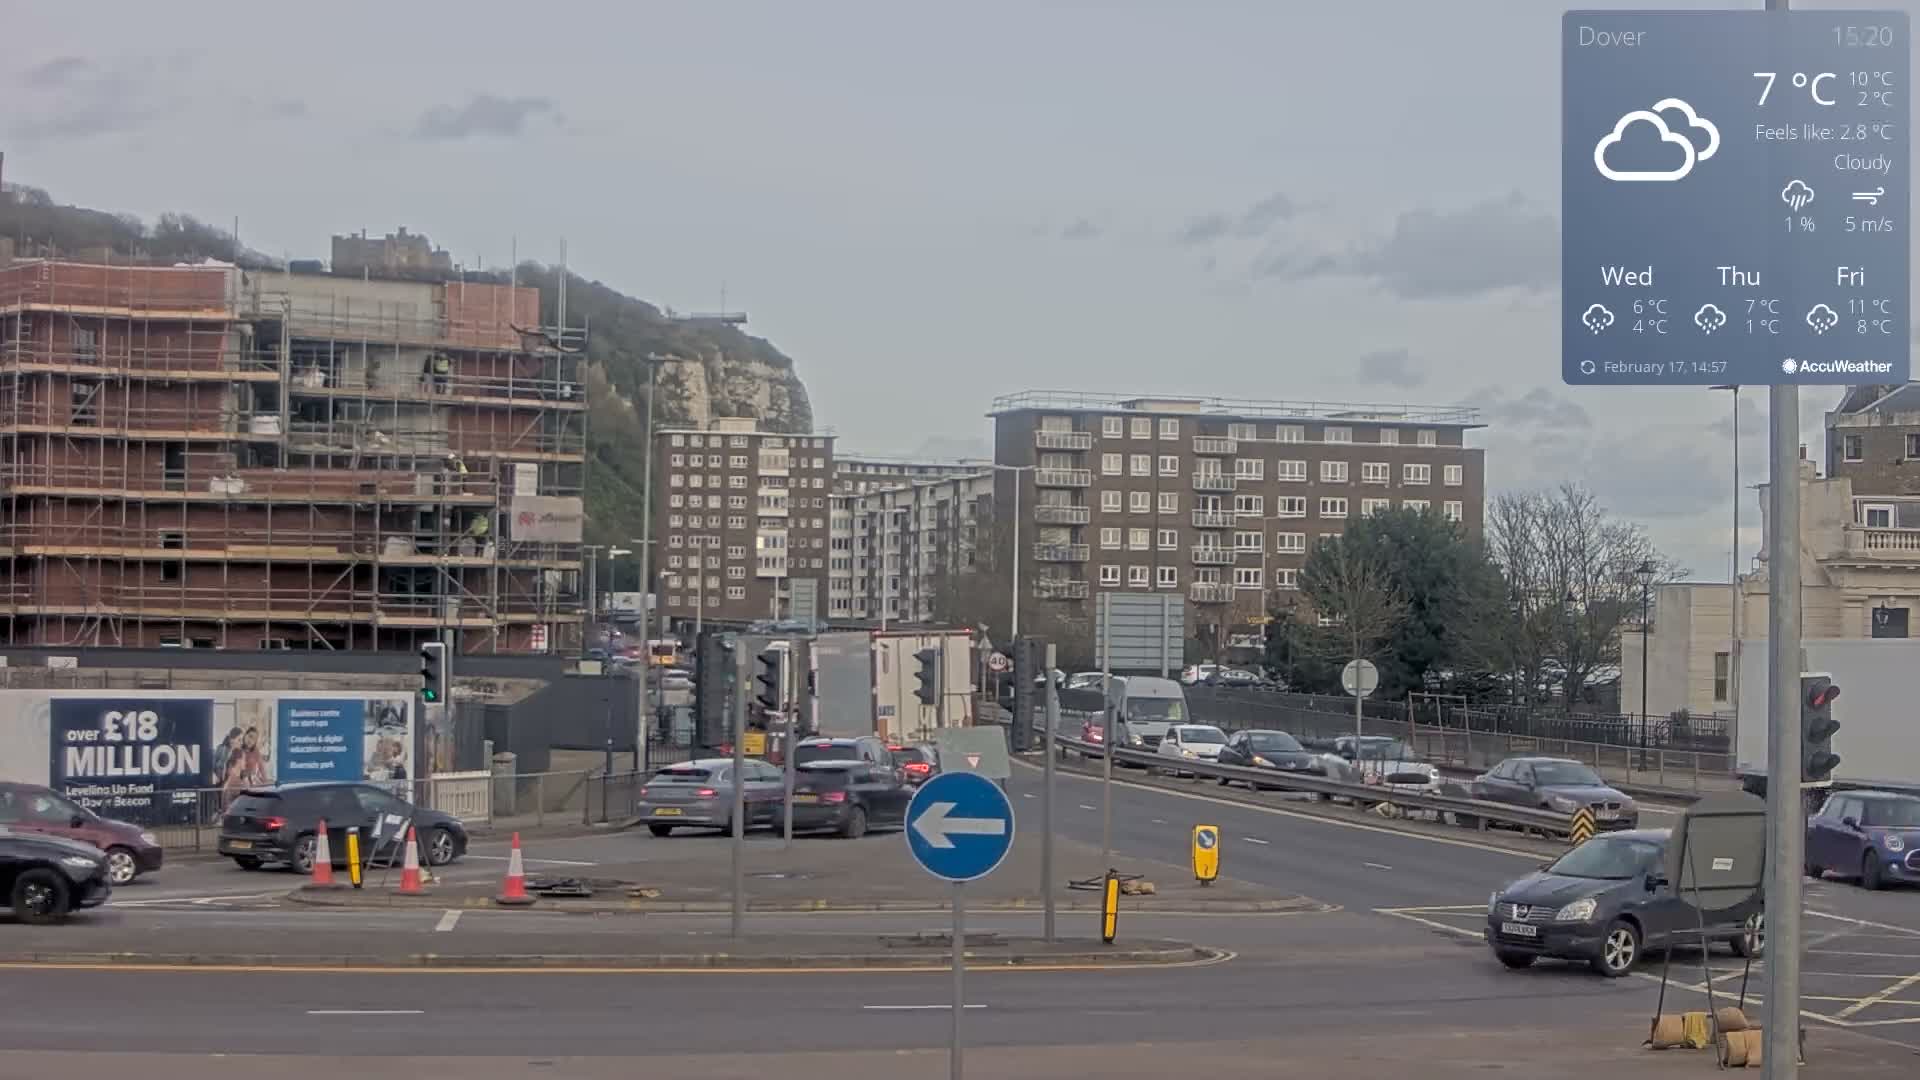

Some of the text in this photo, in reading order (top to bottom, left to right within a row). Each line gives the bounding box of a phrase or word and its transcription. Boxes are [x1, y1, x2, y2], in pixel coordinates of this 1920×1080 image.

[990, 656, 1006, 665] 40
[67, 710, 158, 741] over £18
[66, 744, 200, 777] MILLION
